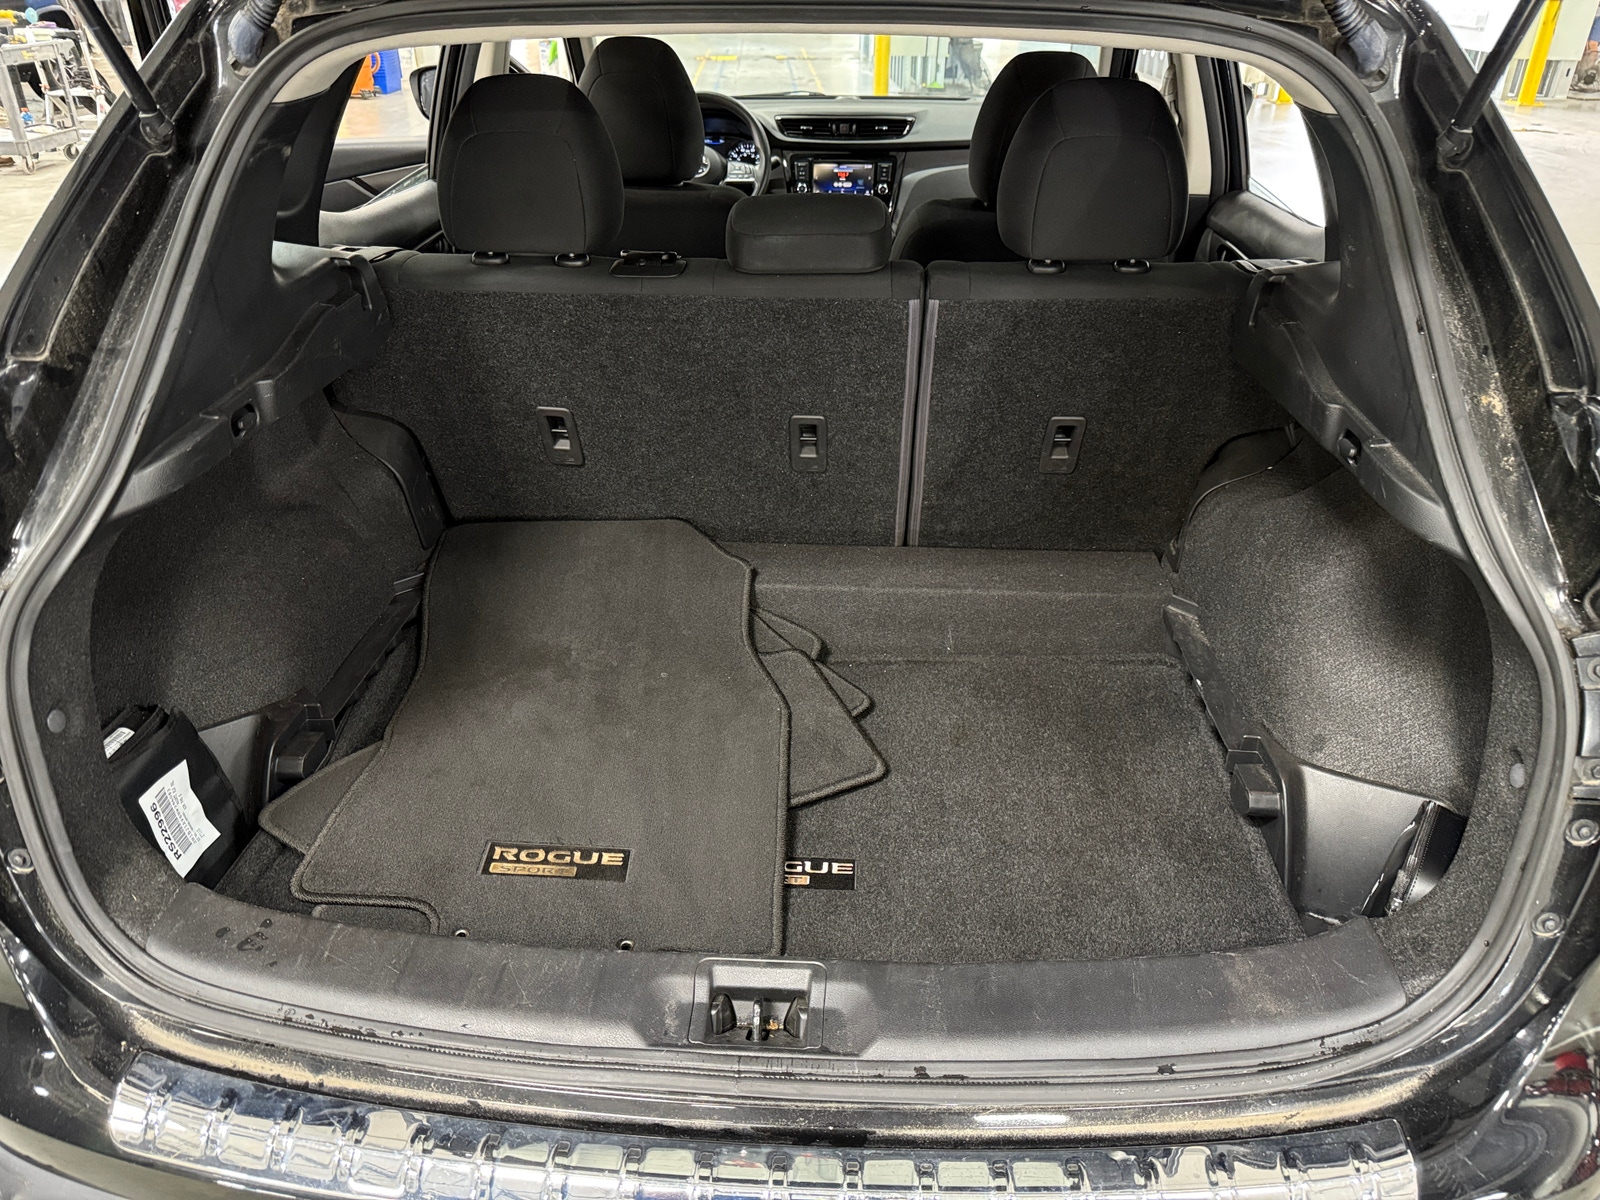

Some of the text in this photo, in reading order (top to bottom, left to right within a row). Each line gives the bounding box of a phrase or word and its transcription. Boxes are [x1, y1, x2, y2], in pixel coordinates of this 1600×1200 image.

[150, 802, 182, 860] RS22996
[492, 846, 625, 866] ROGUE
[498, 865, 567, 875] SPORT
[784, 860, 854, 874] GUE
